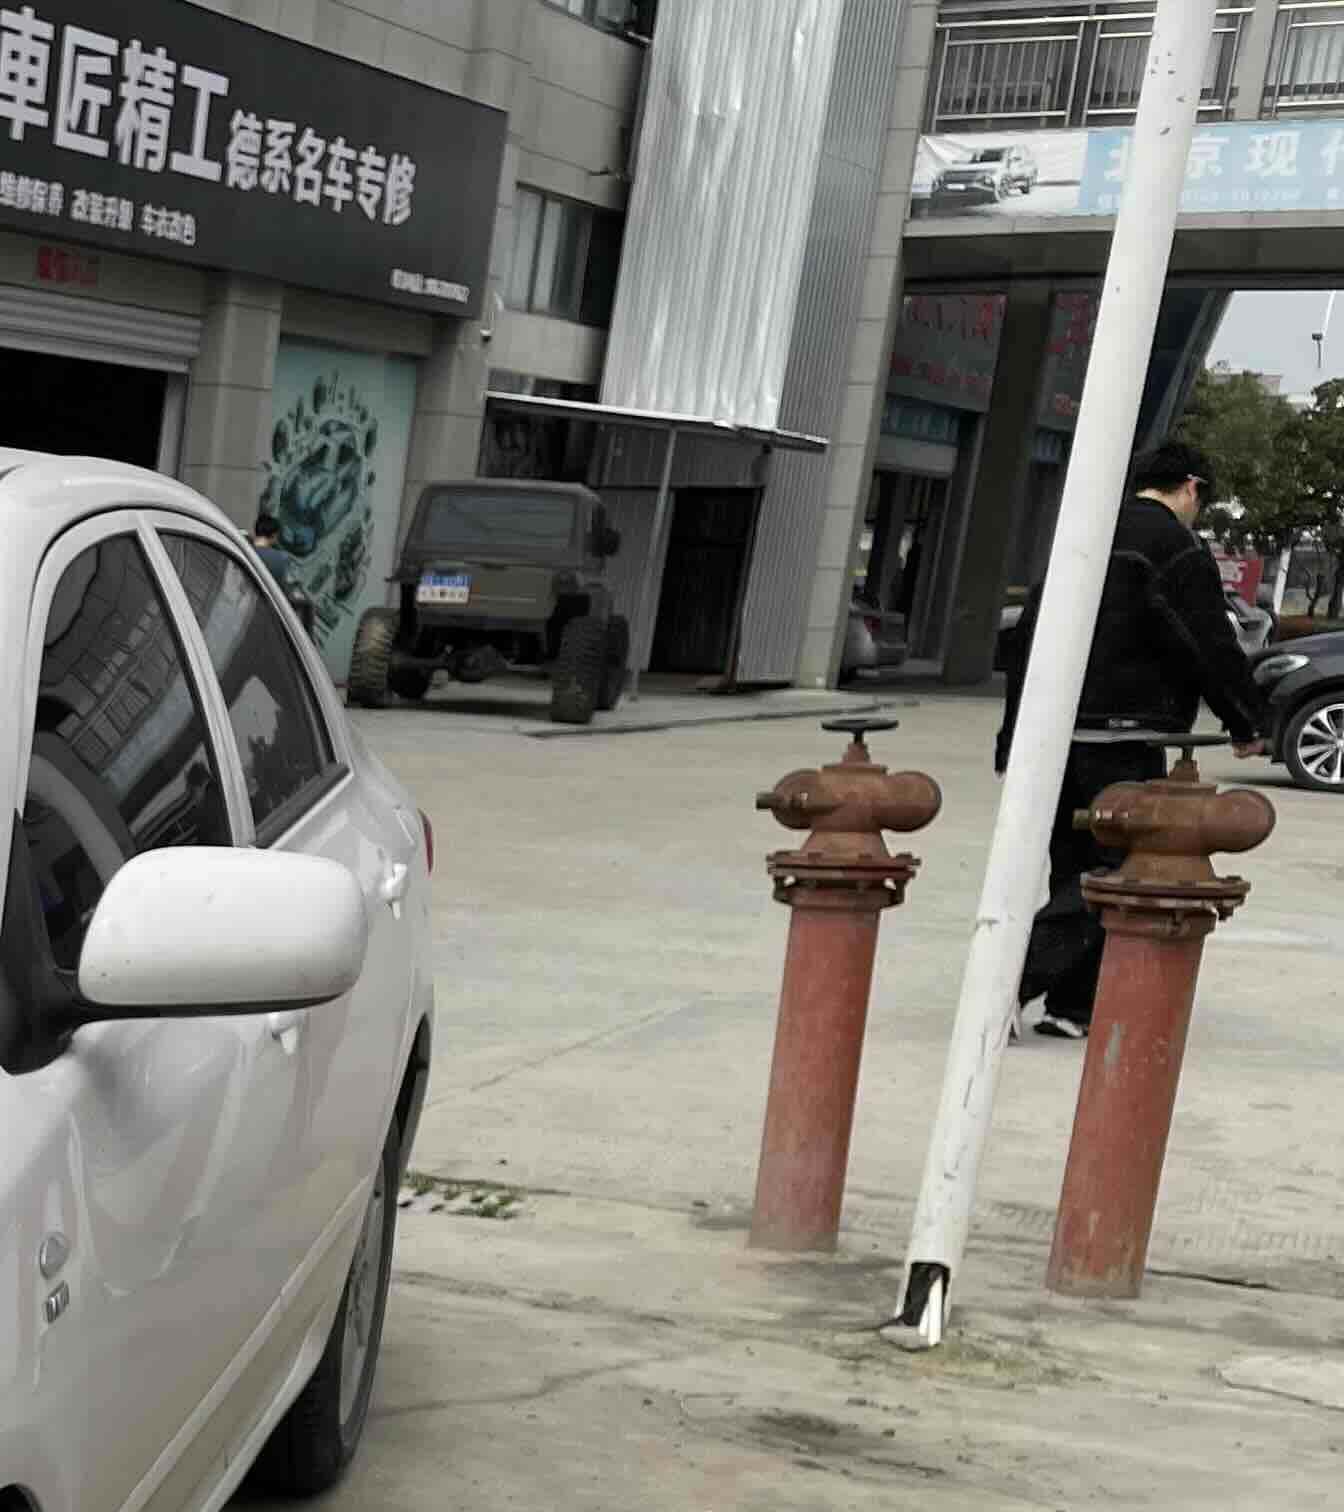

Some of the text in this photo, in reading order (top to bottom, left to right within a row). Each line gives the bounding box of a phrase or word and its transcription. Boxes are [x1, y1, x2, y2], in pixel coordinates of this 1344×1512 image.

[226, 108, 417, 225] 德系名车专修
